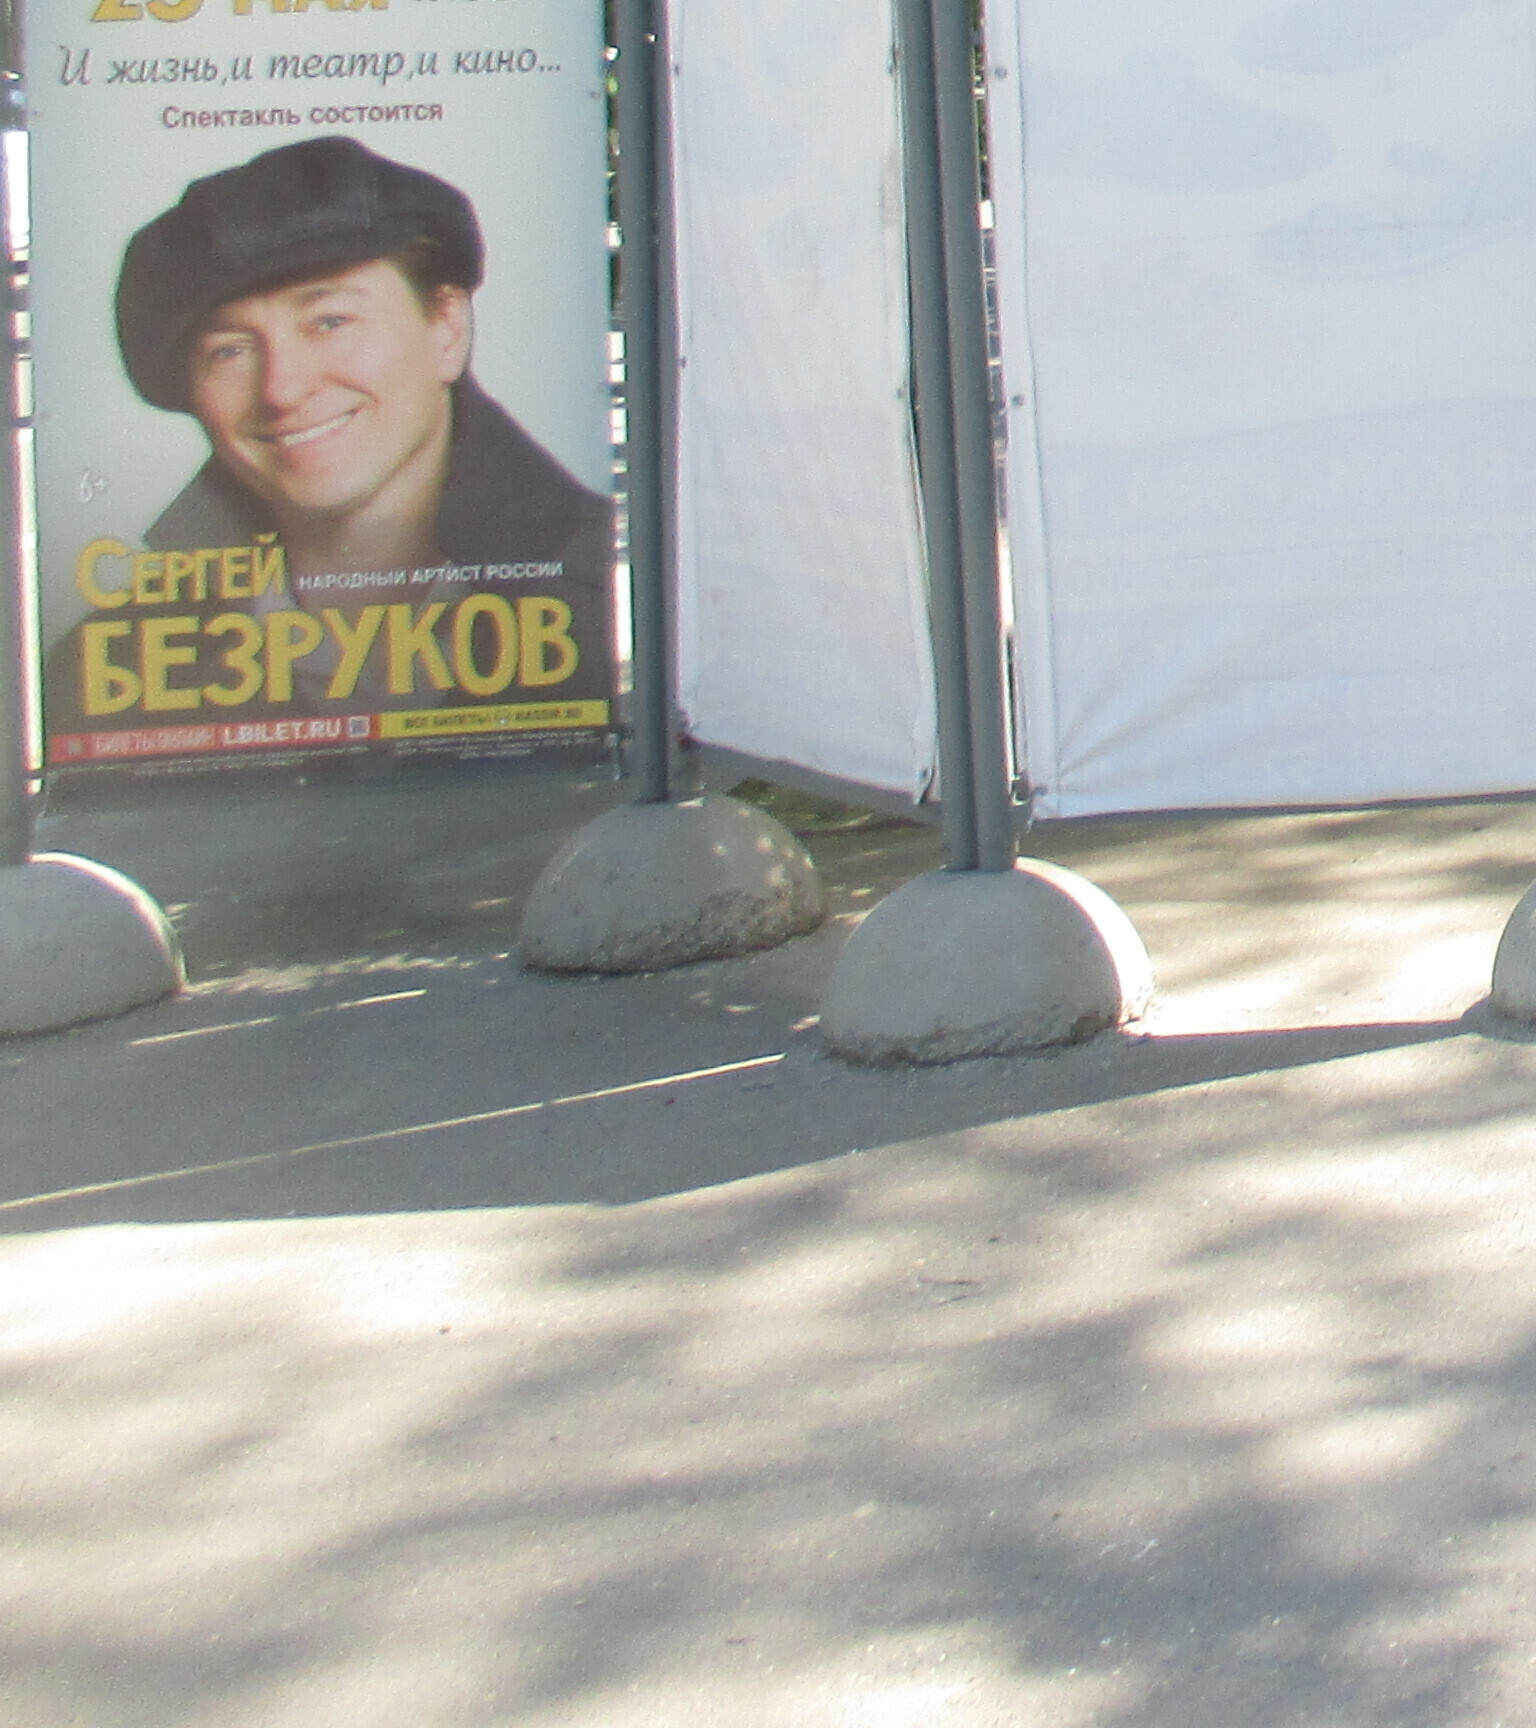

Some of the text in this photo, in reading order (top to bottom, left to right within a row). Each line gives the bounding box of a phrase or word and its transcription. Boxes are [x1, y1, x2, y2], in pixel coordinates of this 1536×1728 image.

[59, 44, 92, 86] И
[161, 103, 444, 129] Спектакль состоится
[299, 561, 565, 590] НАРОДНЫЙ АРТИСТ РОССИИ
[82, 592, 580, 717] БЕЗРУКОВ
